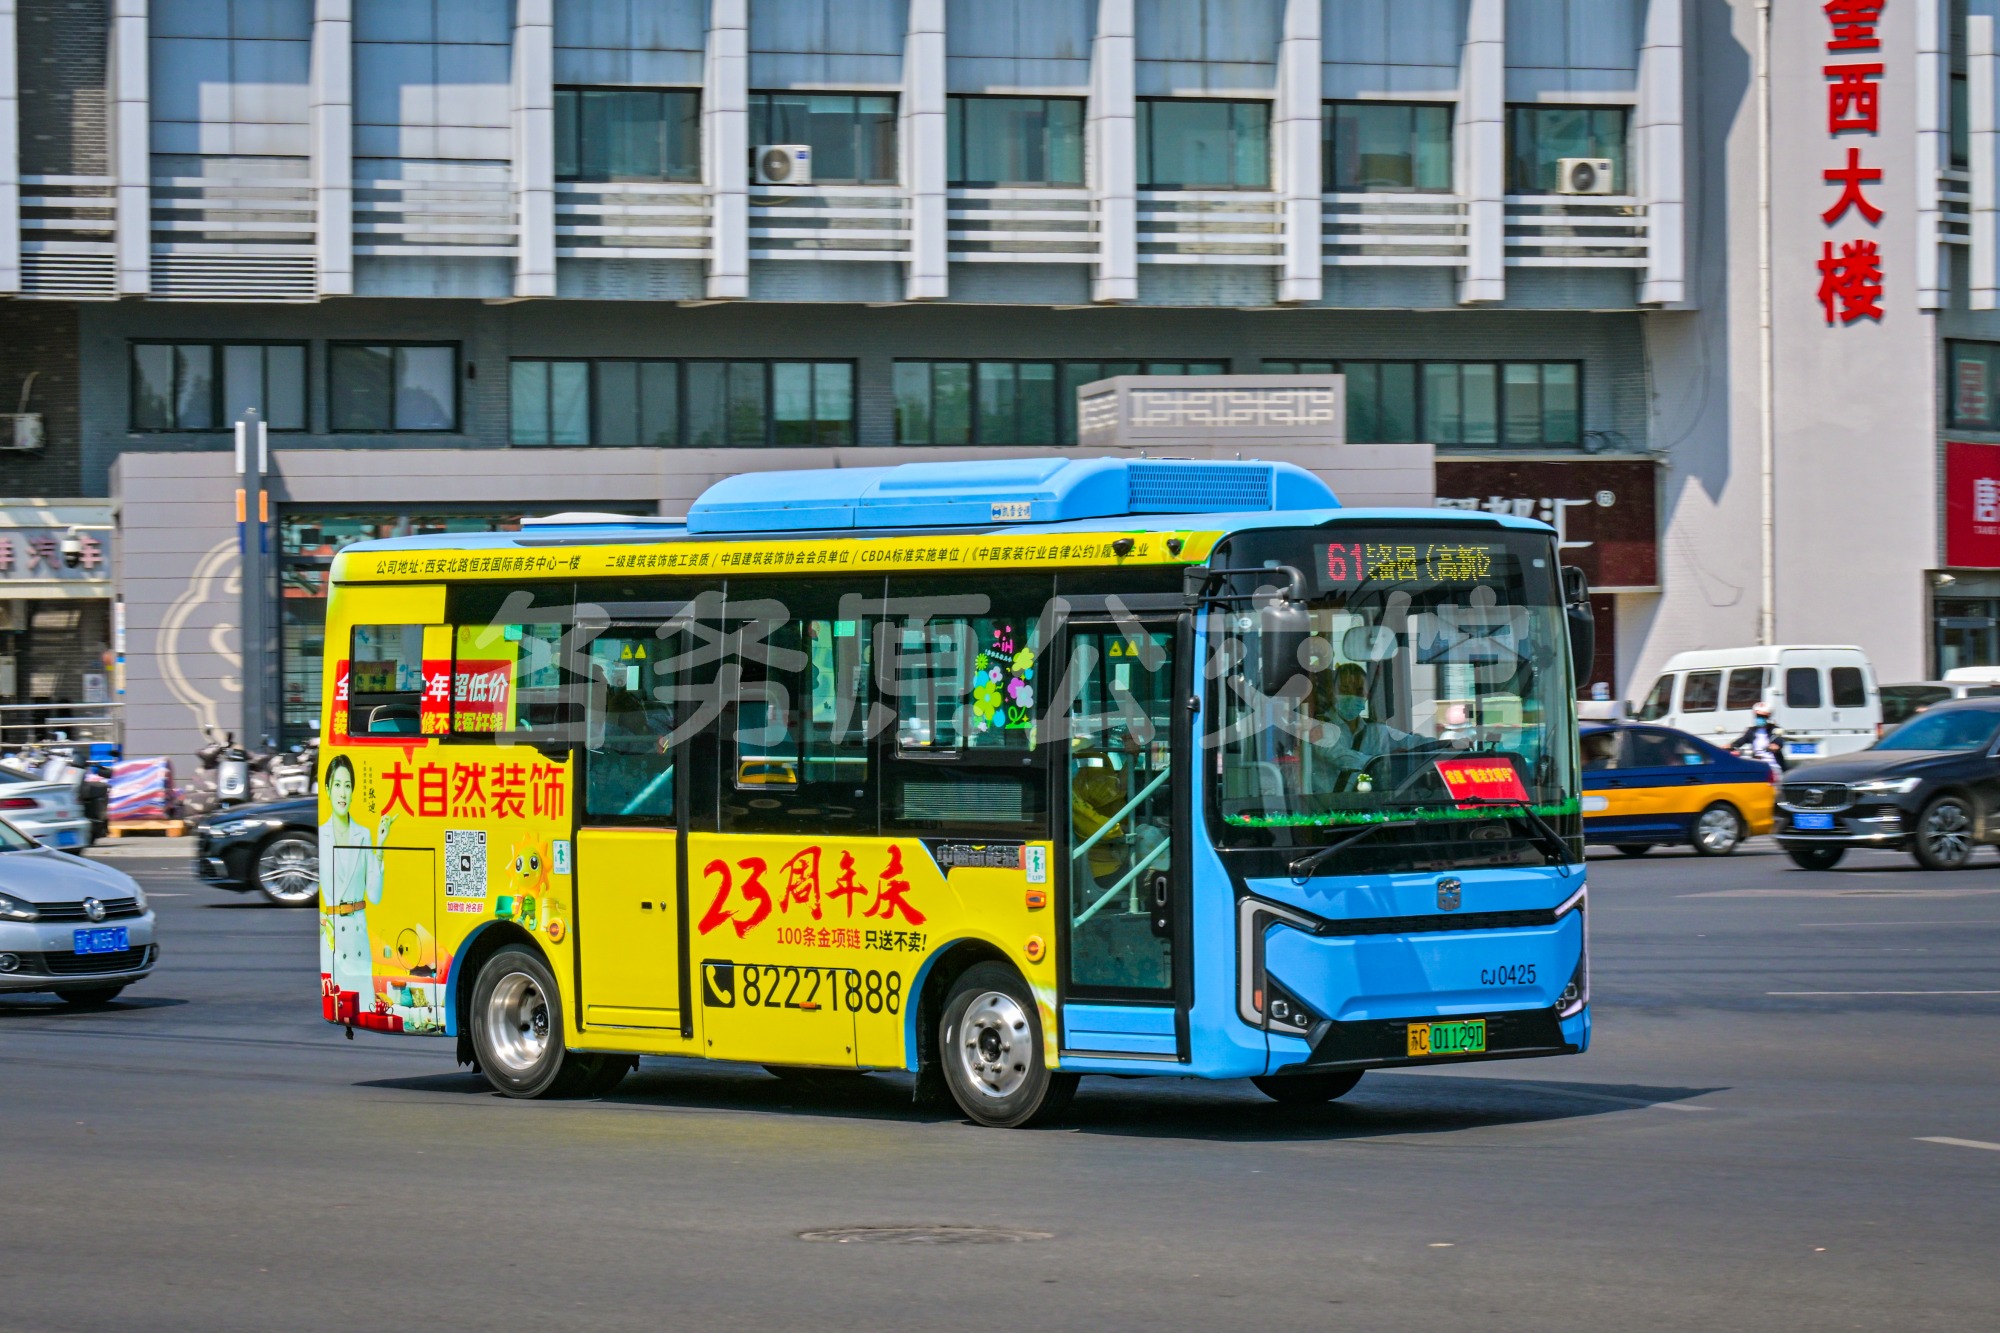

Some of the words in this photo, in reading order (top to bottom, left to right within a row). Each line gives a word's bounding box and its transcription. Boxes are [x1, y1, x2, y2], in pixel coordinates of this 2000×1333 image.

[381, 761, 565, 821] 大自然装饰
[698, 844, 927, 939] 23周年庆
[777, 926, 861, 950] 100条金项链
[865, 930, 927, 953] 只送不卖!
[742, 964, 902, 1016] 82221888
[1480, 963, 1537, 985] CJ0425
